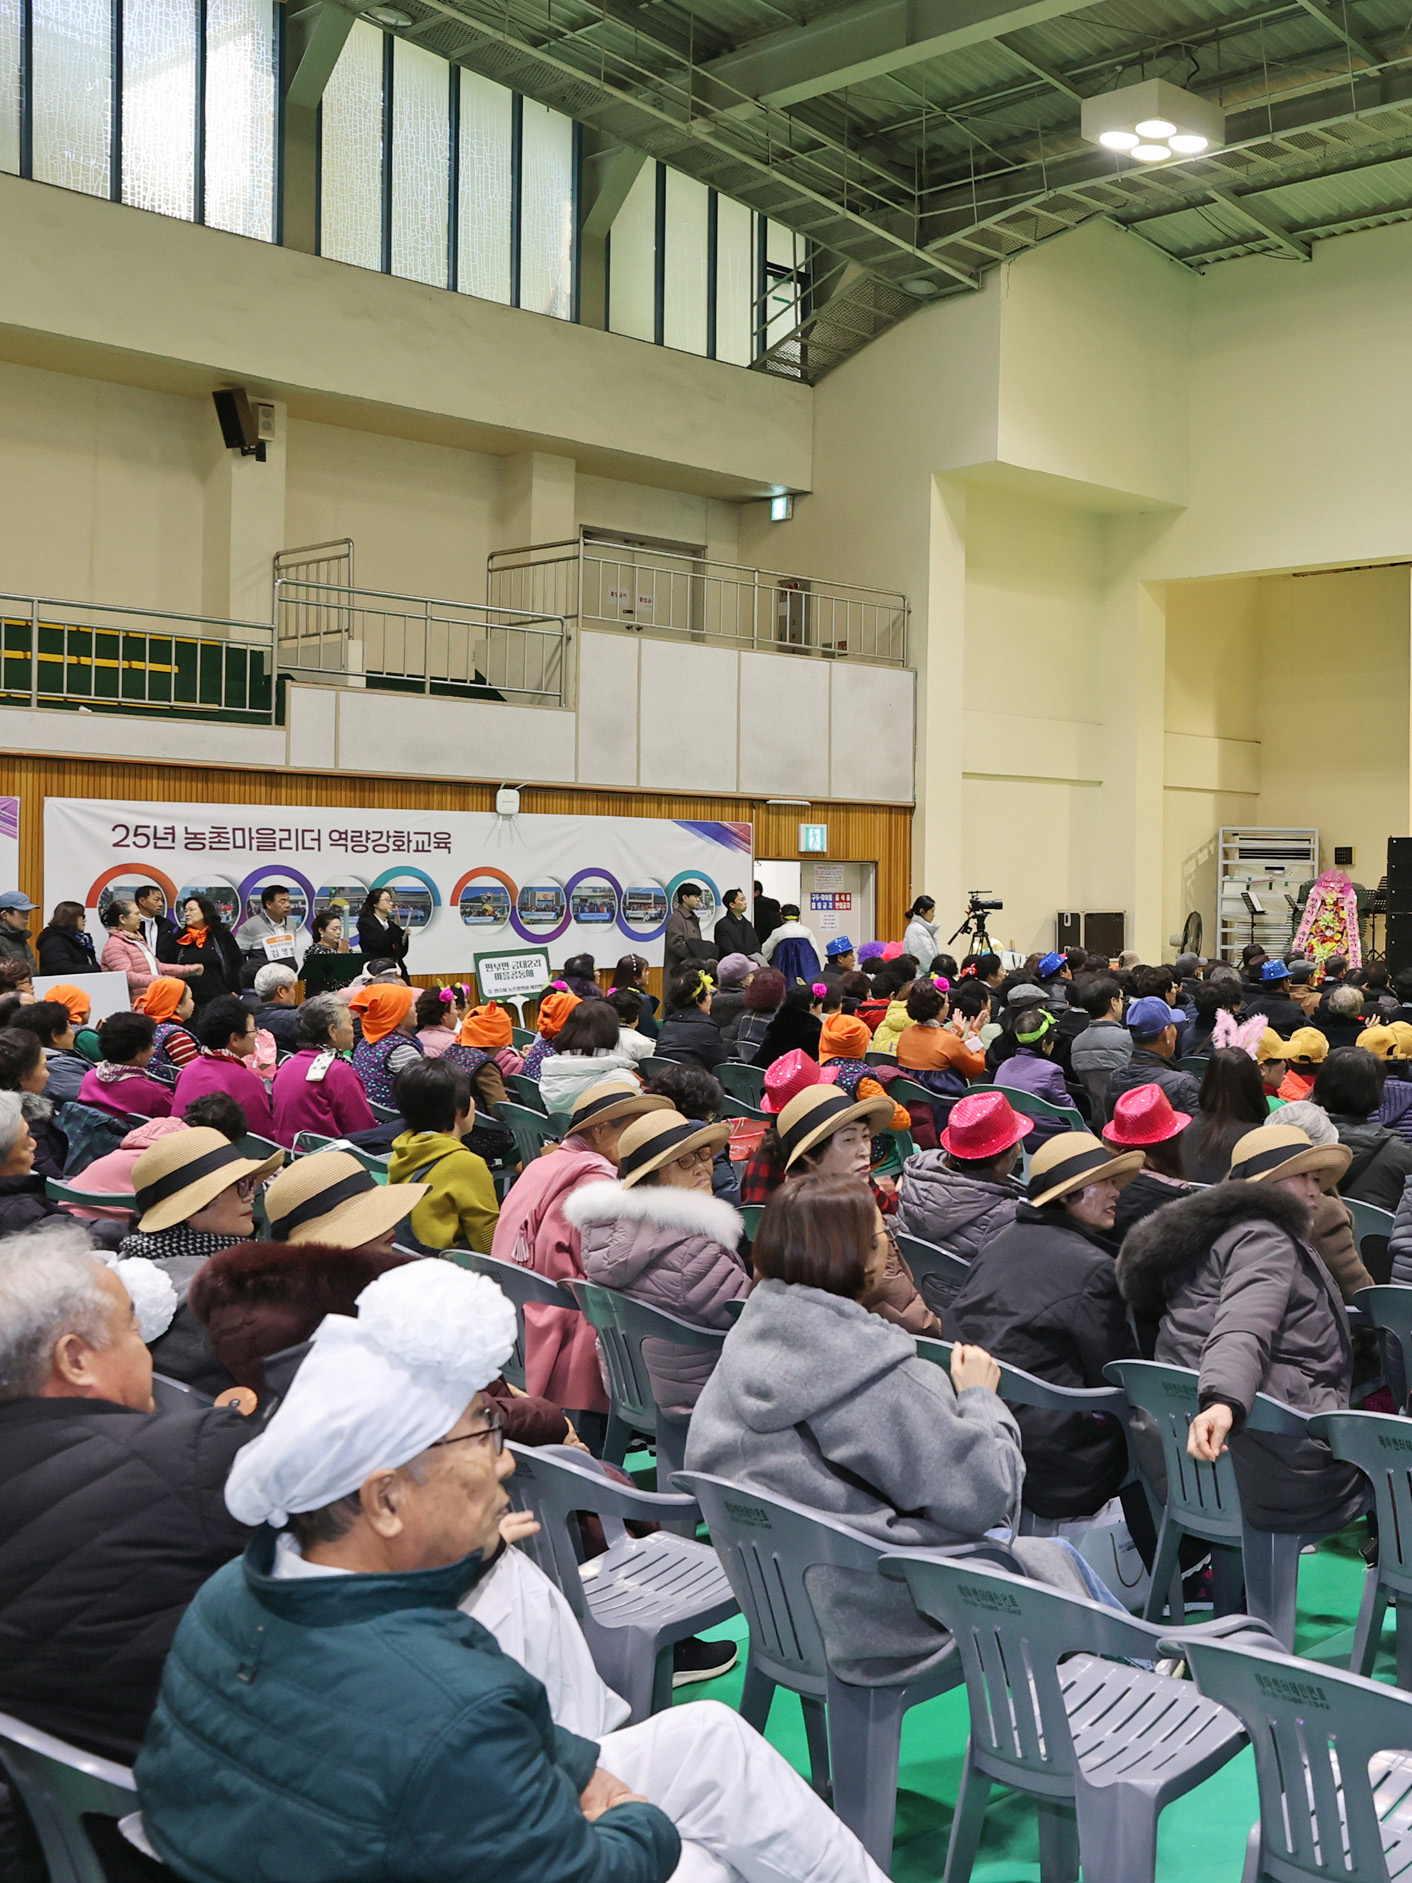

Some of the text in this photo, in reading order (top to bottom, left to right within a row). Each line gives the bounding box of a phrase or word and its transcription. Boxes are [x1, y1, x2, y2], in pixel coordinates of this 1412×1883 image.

[111, 824, 452, 854] 25년 농촌마을리더 역량강화교육
